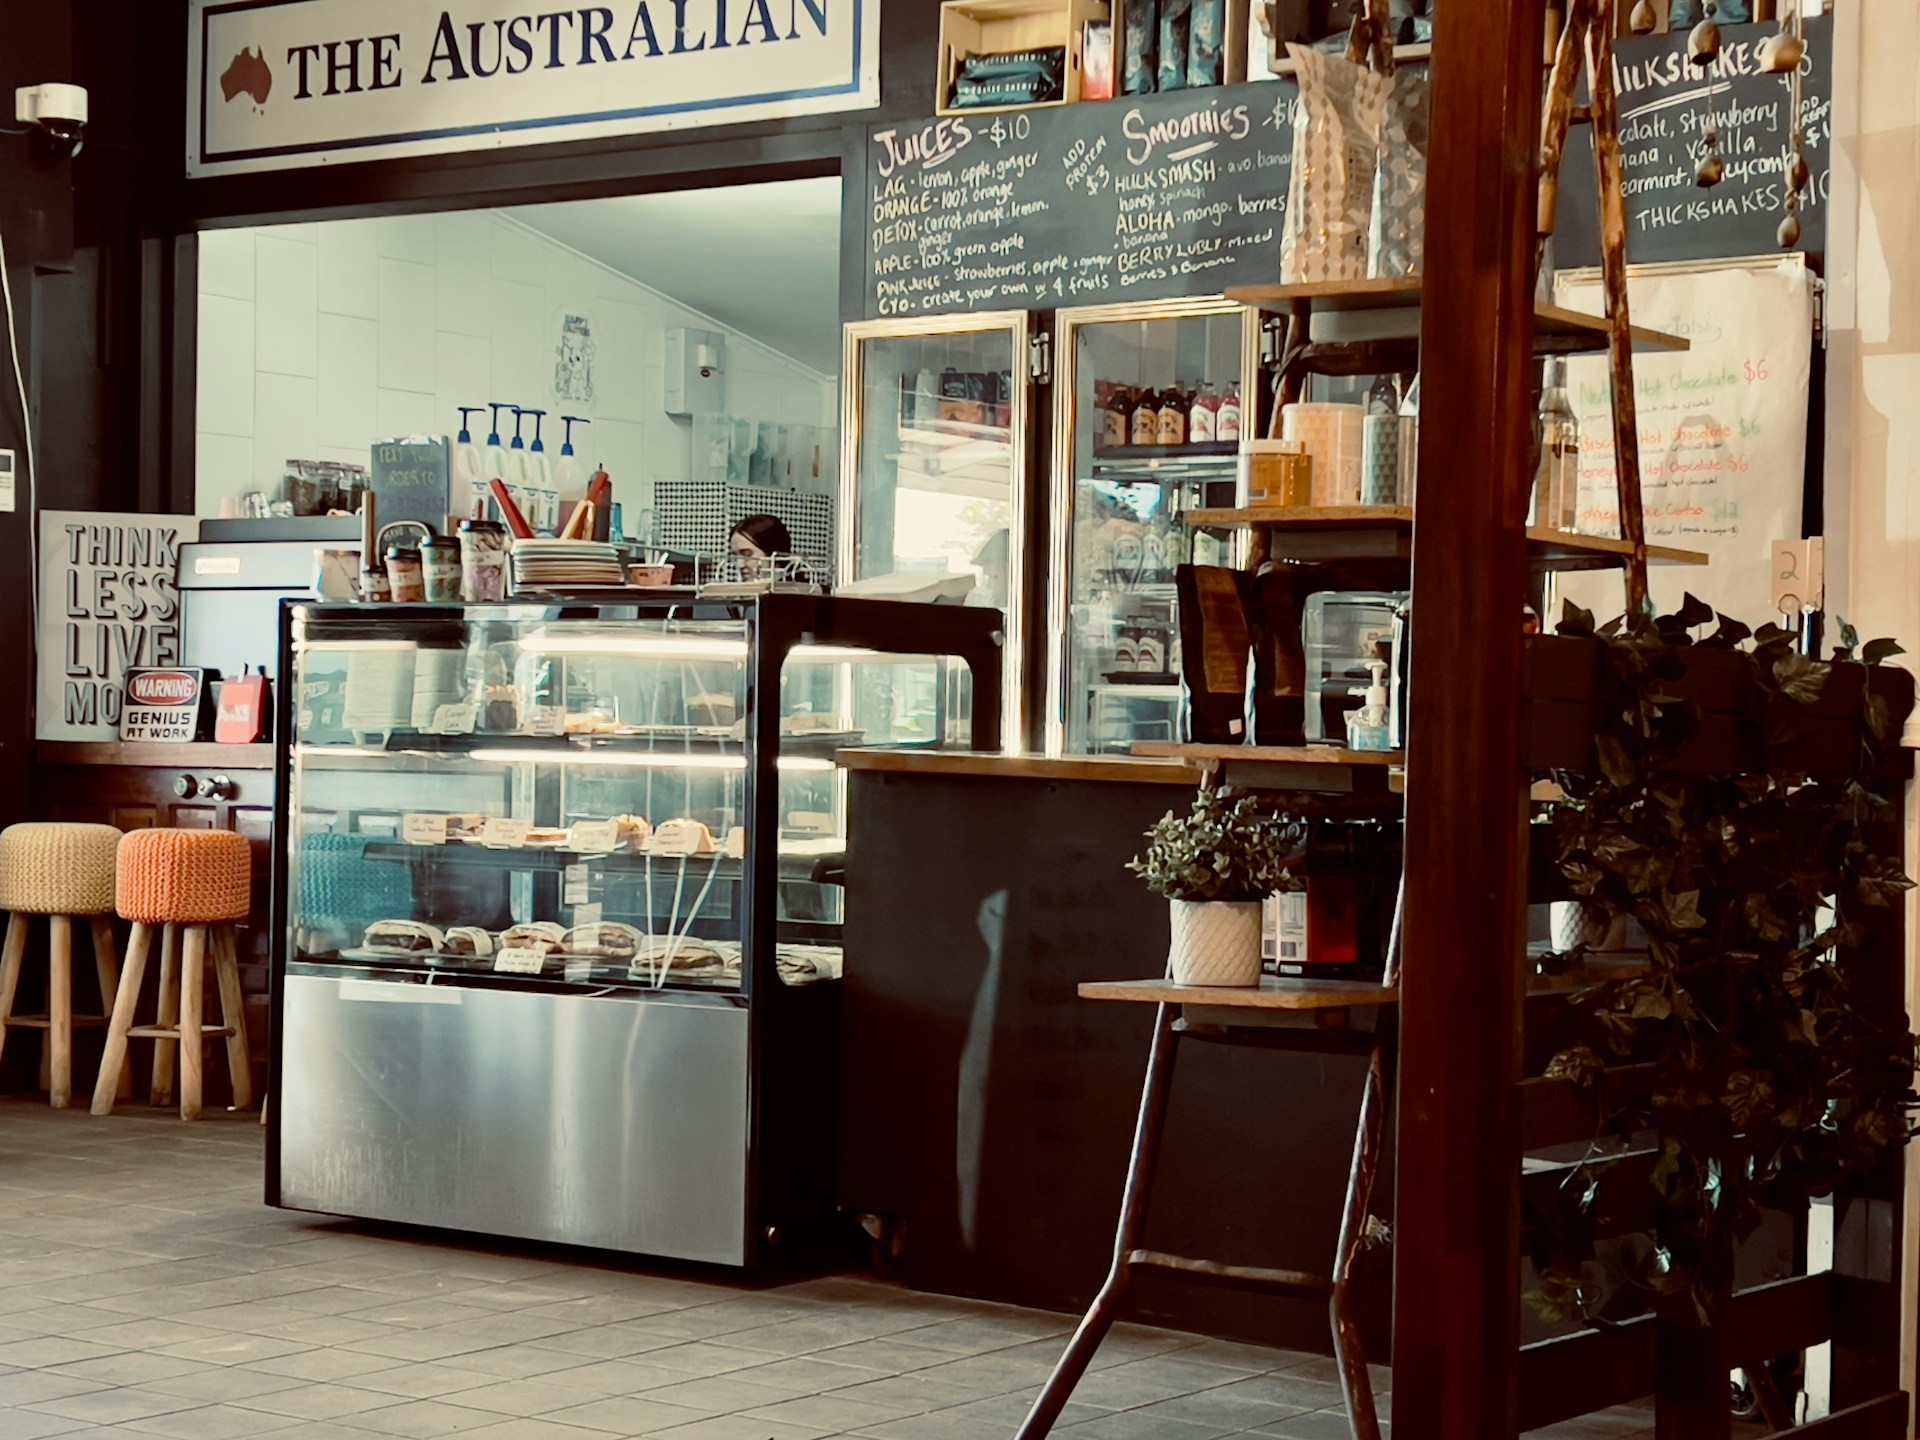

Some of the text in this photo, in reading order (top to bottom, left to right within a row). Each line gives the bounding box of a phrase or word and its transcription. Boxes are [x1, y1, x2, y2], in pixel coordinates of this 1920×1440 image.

[287, 0, 828, 99] THE AUSTRALIAN
[873, 117, 972, 177] JUICES
[1063, 139, 1085, 169] ADD
[874, 175, 906, 202] LAG
[1115, 170, 1157, 193] HULK
[1158, 159, 1216, 189] SMASH
[973, 182, 1013, 206] orange
[1636, 184, 1781, 230] THICKSHAKES
[1116, 210, 1175, 235] ALOHA
[1238, 193, 1286, 215] berries
[872, 216, 918, 253] DETOX
[875, 255, 912, 275] APPLE
[990, 232, 1024, 257] apple
[1118, 244, 1173, 273] BERRY
[967, 285, 998, 310] your
[1001, 283, 1028, 295] own
[1744, 358, 1769, 385] $6
[65, 524, 178, 568] THINK
[1779, 550, 1800, 581] 2
[66, 568, 177, 621] LESS
[65, 622, 178, 679] LIVE
[64, 681, 121, 726] MO
[133, 674, 194, 699] WARNING
[126, 728, 189, 739] AT WORK
[128, 712, 191, 726] GENIUS
